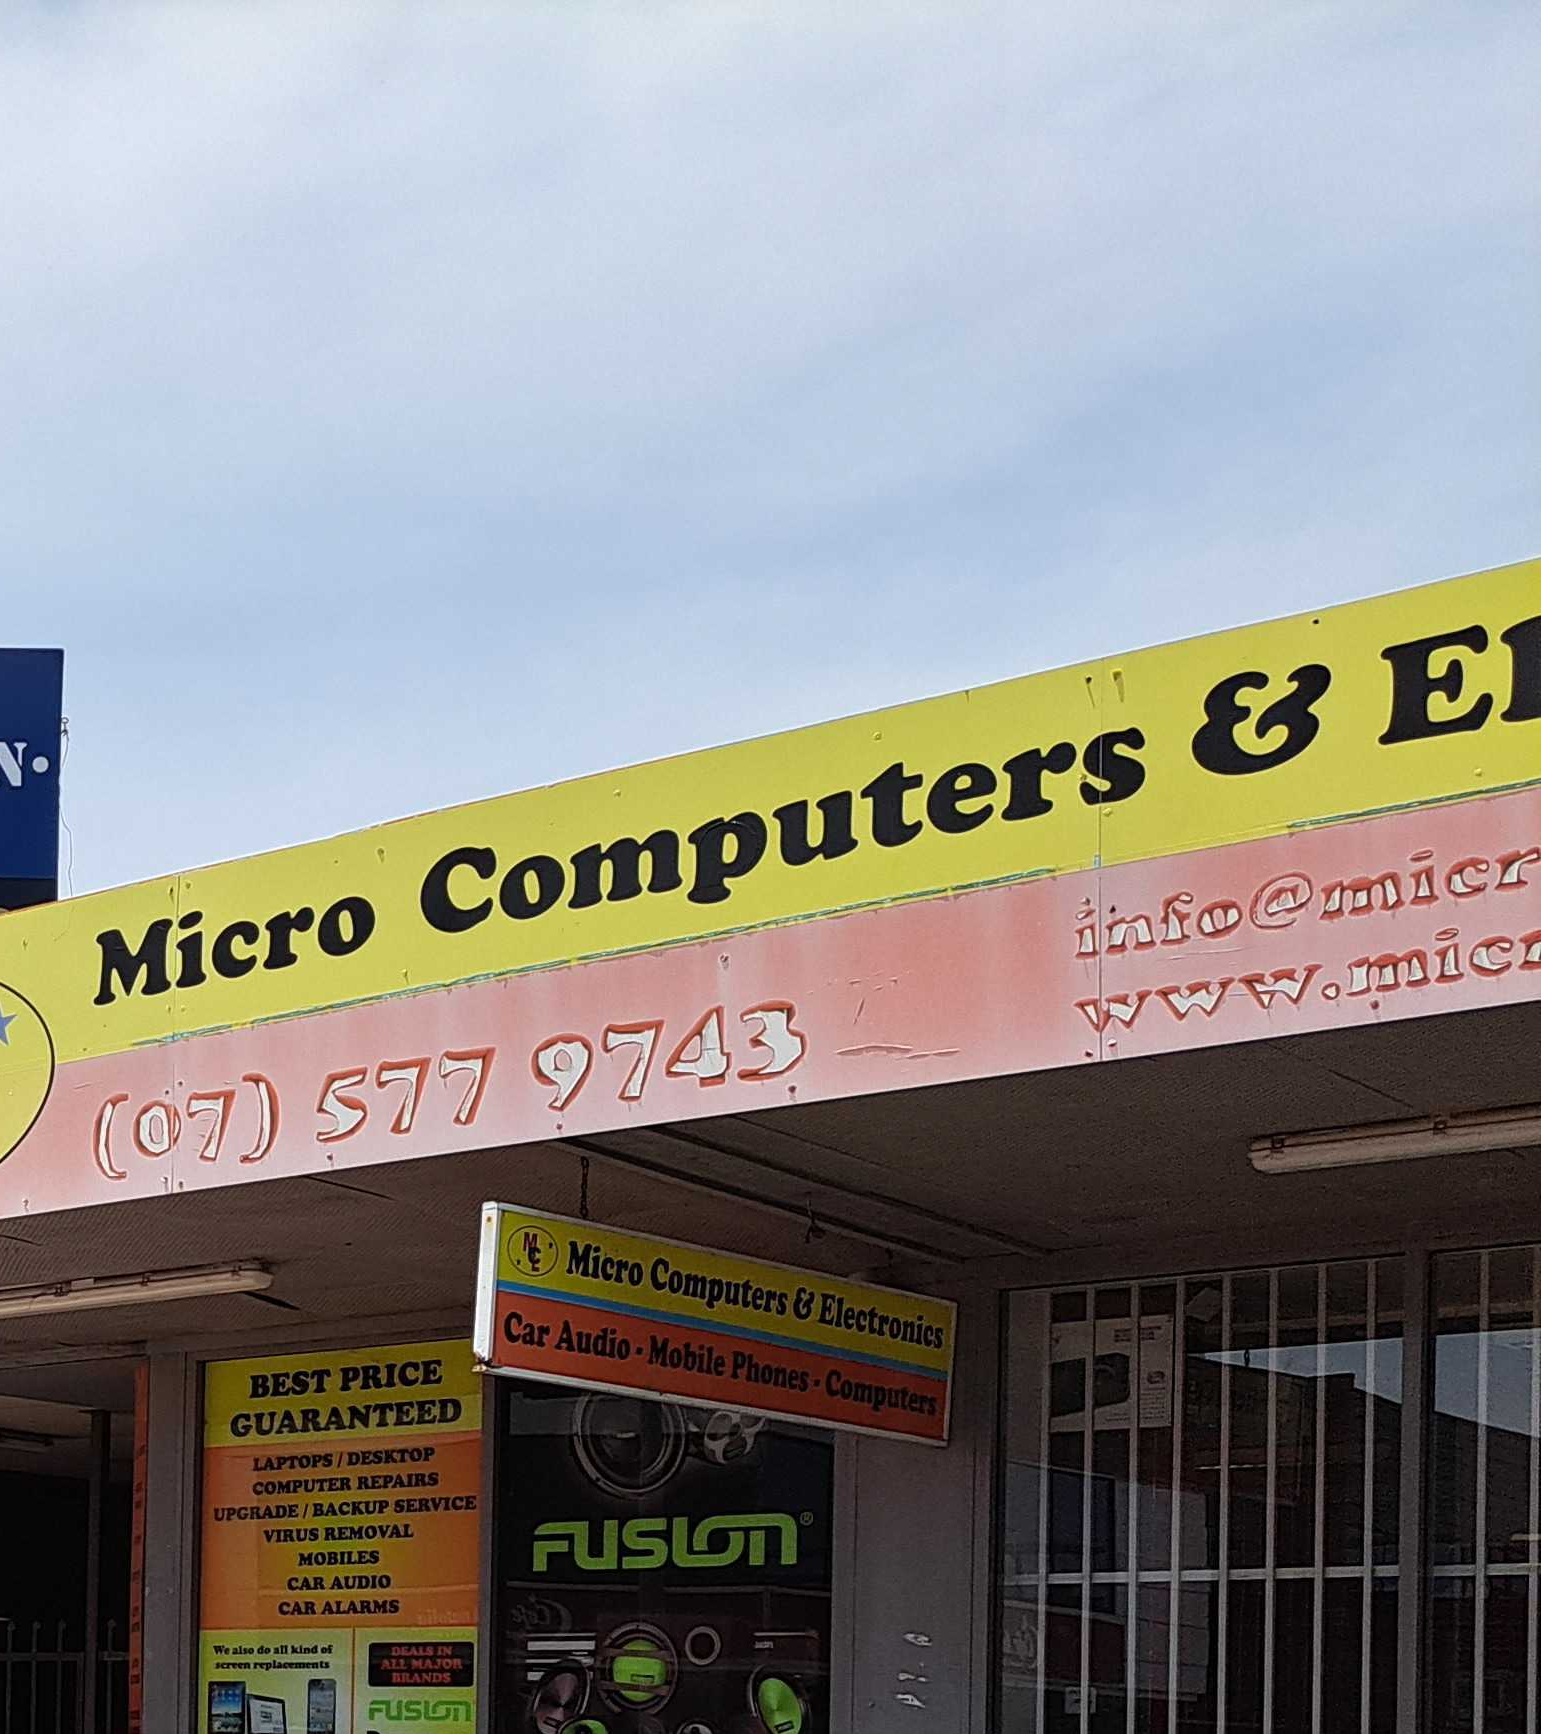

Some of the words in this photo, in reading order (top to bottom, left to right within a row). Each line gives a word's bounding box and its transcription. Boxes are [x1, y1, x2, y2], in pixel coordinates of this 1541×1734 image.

[93, 896, 376, 1006] Micro
[419, 726, 1147, 932] Computers
[1191, 663, 1332, 776] &
[93, 1073, 280, 1180] (07)
[316, 1046, 496, 1143] 577
[531, 1000, 808, 1114] 9743
[566, 1240, 643, 1287] Micro
[650, 1257, 789, 1318] Computers
[793, 1286, 815, 1319] &
[819, 1293, 944, 1350] Electronics
[503, 1311, 550, 1348] Car
[555, 1320, 631, 1360] Audio
[648, 1334, 725, 1377] Mobile
[731, 1350, 810, 1393] Phones
[824, 1369, 939, 1417] Computers
[249, 1371, 332, 1399] BEST
[340, 1359, 444, 1392] PRICE
[230, 1398, 462, 1438] GUARANTEED
[252, 1452, 333, 1473] LAPTOPS
[347, 1447, 435, 1466] DESKTOP
[252, 1477, 351, 1496] COMPUTER
[357, 1472, 439, 1490] REPAIRS
[213, 1502, 299, 1522] UPGRADE
[312, 1499, 390, 1518] BACKUP
[394, 1495, 477, 1513] SERVICE
[264, 1527, 319, 1543] VIRUS
[324, 1524, 414, 1541] REMOVAL
[533, 1513, 799, 1572] FUSION
[298, 1550, 380, 1566] MOBILES
[287, 1576, 325, 1591] CAR
[329, 1574, 392, 1590] AUDIO
[278, 1601, 319, 1615] CAR
[323, 1599, 400, 1615] ALARMS
[213, 1645, 230, 1655] We
[232, 1645, 255, 1655] also
[257, 1645, 271, 1655] do
[273, 1645, 288, 1655] all
[291, 1645, 318, 1655] kind
[321, 1645, 333, 1654] of
[391, 1646, 434, 1656] DEALS
[437, 1646, 453, 1656] IN
[215, 1661, 251, 1670] screen
[253, 1660, 330, 1671] replacements
[381, 1659, 407, 1670] ALL
[411, 1658, 463, 1669] MAJOR
[392, 1672, 451, 1683] BRANDS
[368, 1700, 472, 1721] FUSION
